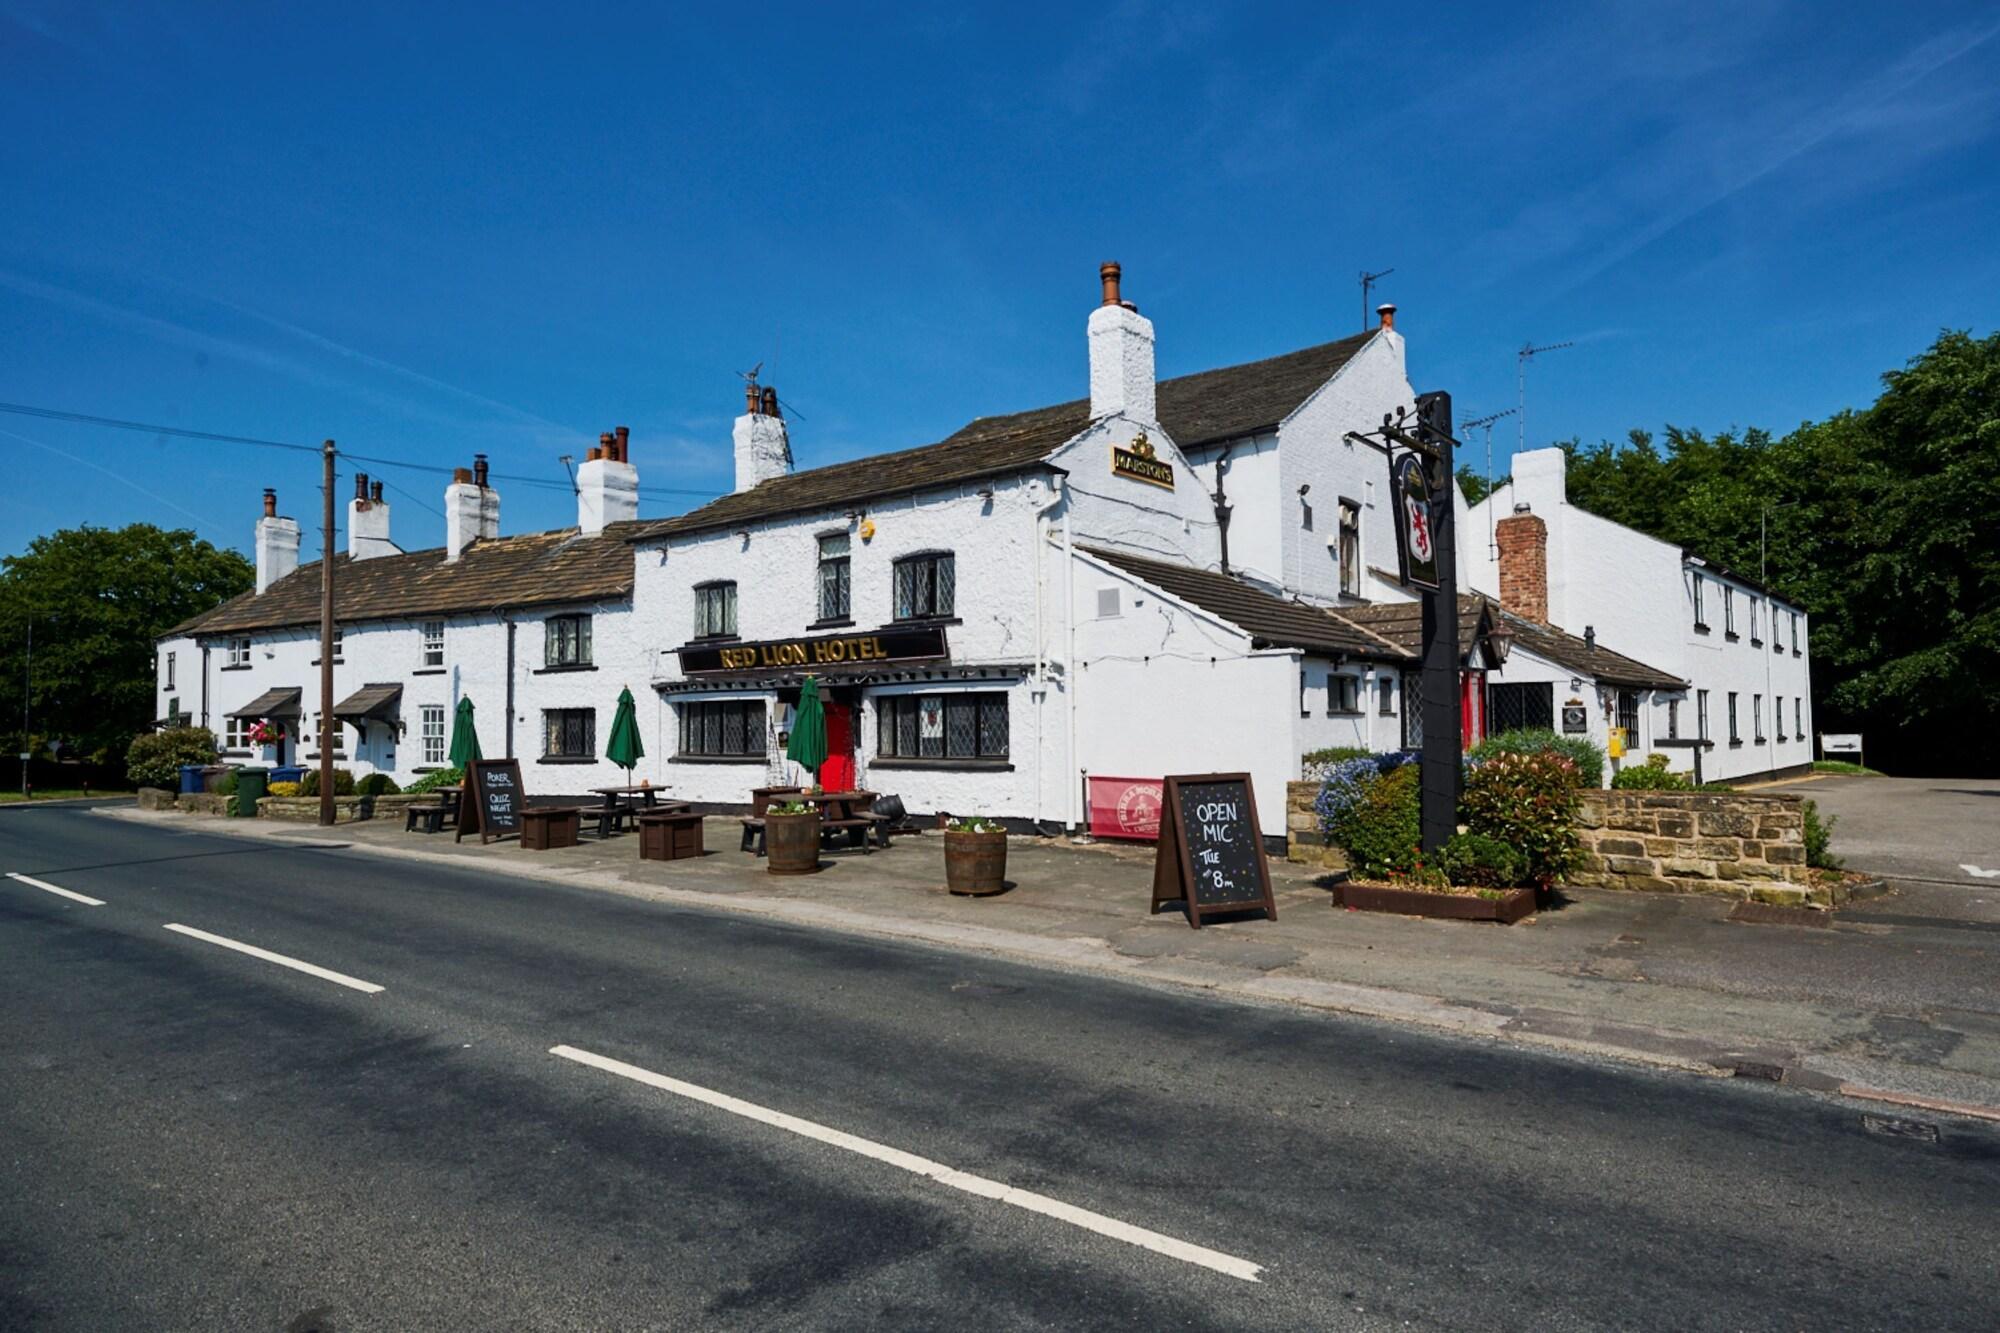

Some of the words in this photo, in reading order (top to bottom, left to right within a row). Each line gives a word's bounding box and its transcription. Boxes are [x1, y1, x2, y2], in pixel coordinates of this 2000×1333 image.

[719, 647, 756, 668] RED
[761, 644, 808, 665] LION
[813, 636, 887, 662] HOTEL
[489, 793, 511, 803] QUIZ
[1196, 802, 1238, 823] OPEN
[1203, 824, 1234, 843] MIC
